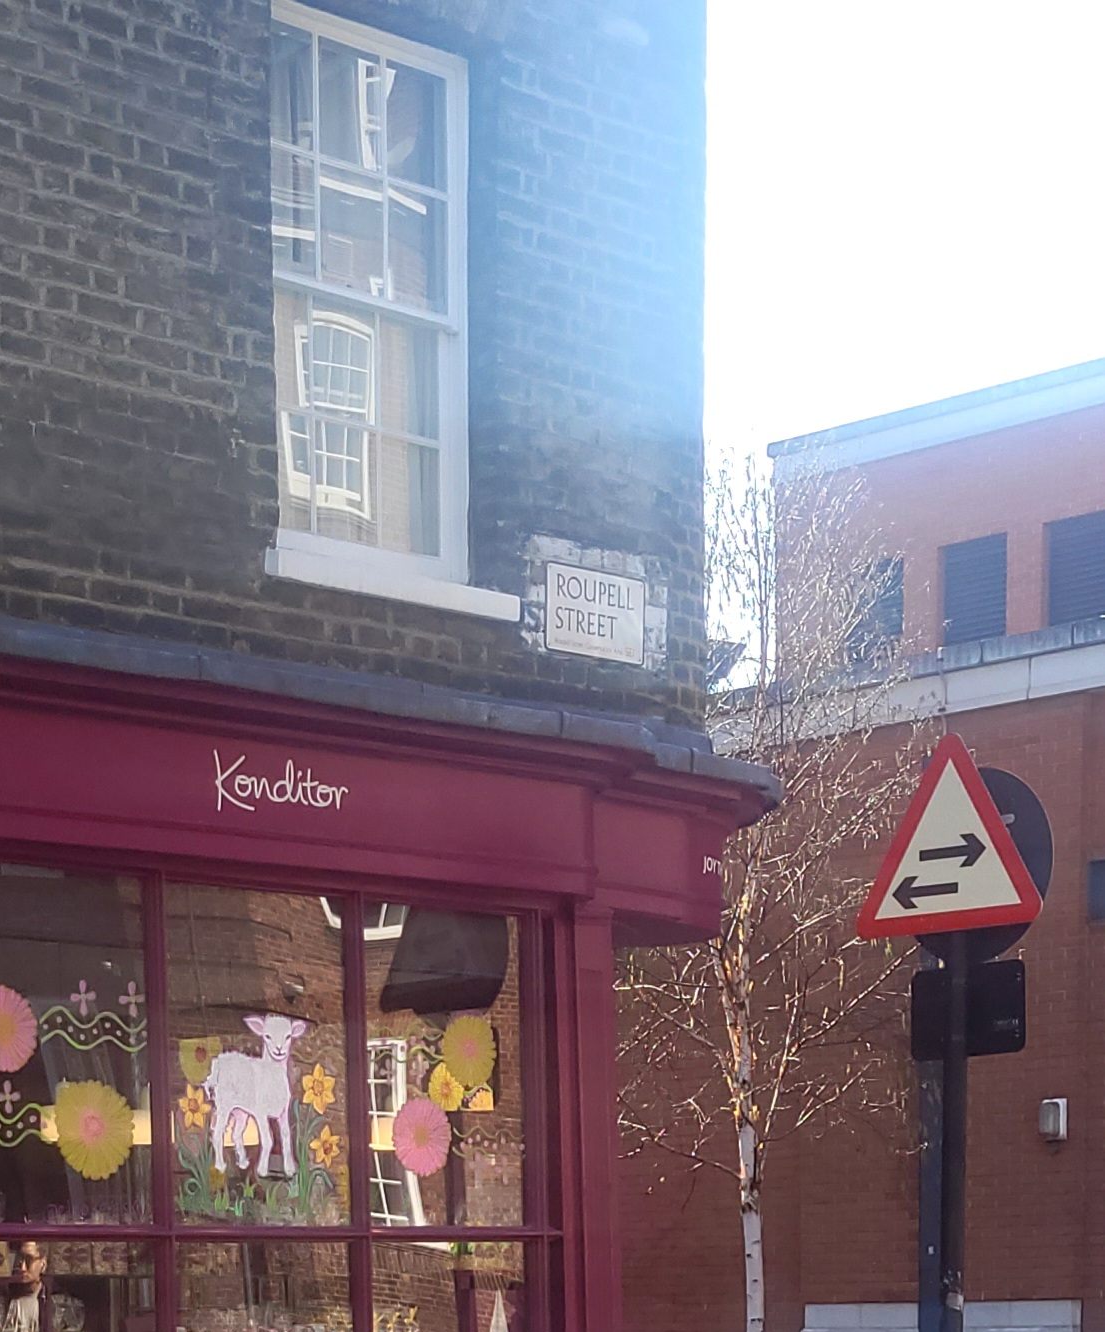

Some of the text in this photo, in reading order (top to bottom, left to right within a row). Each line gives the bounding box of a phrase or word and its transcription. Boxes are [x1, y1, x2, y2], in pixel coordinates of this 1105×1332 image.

[556, 573, 635, 611] ROUPELL
[555, 606, 618, 640] STREET
[214, 749, 349, 812] Konditor
